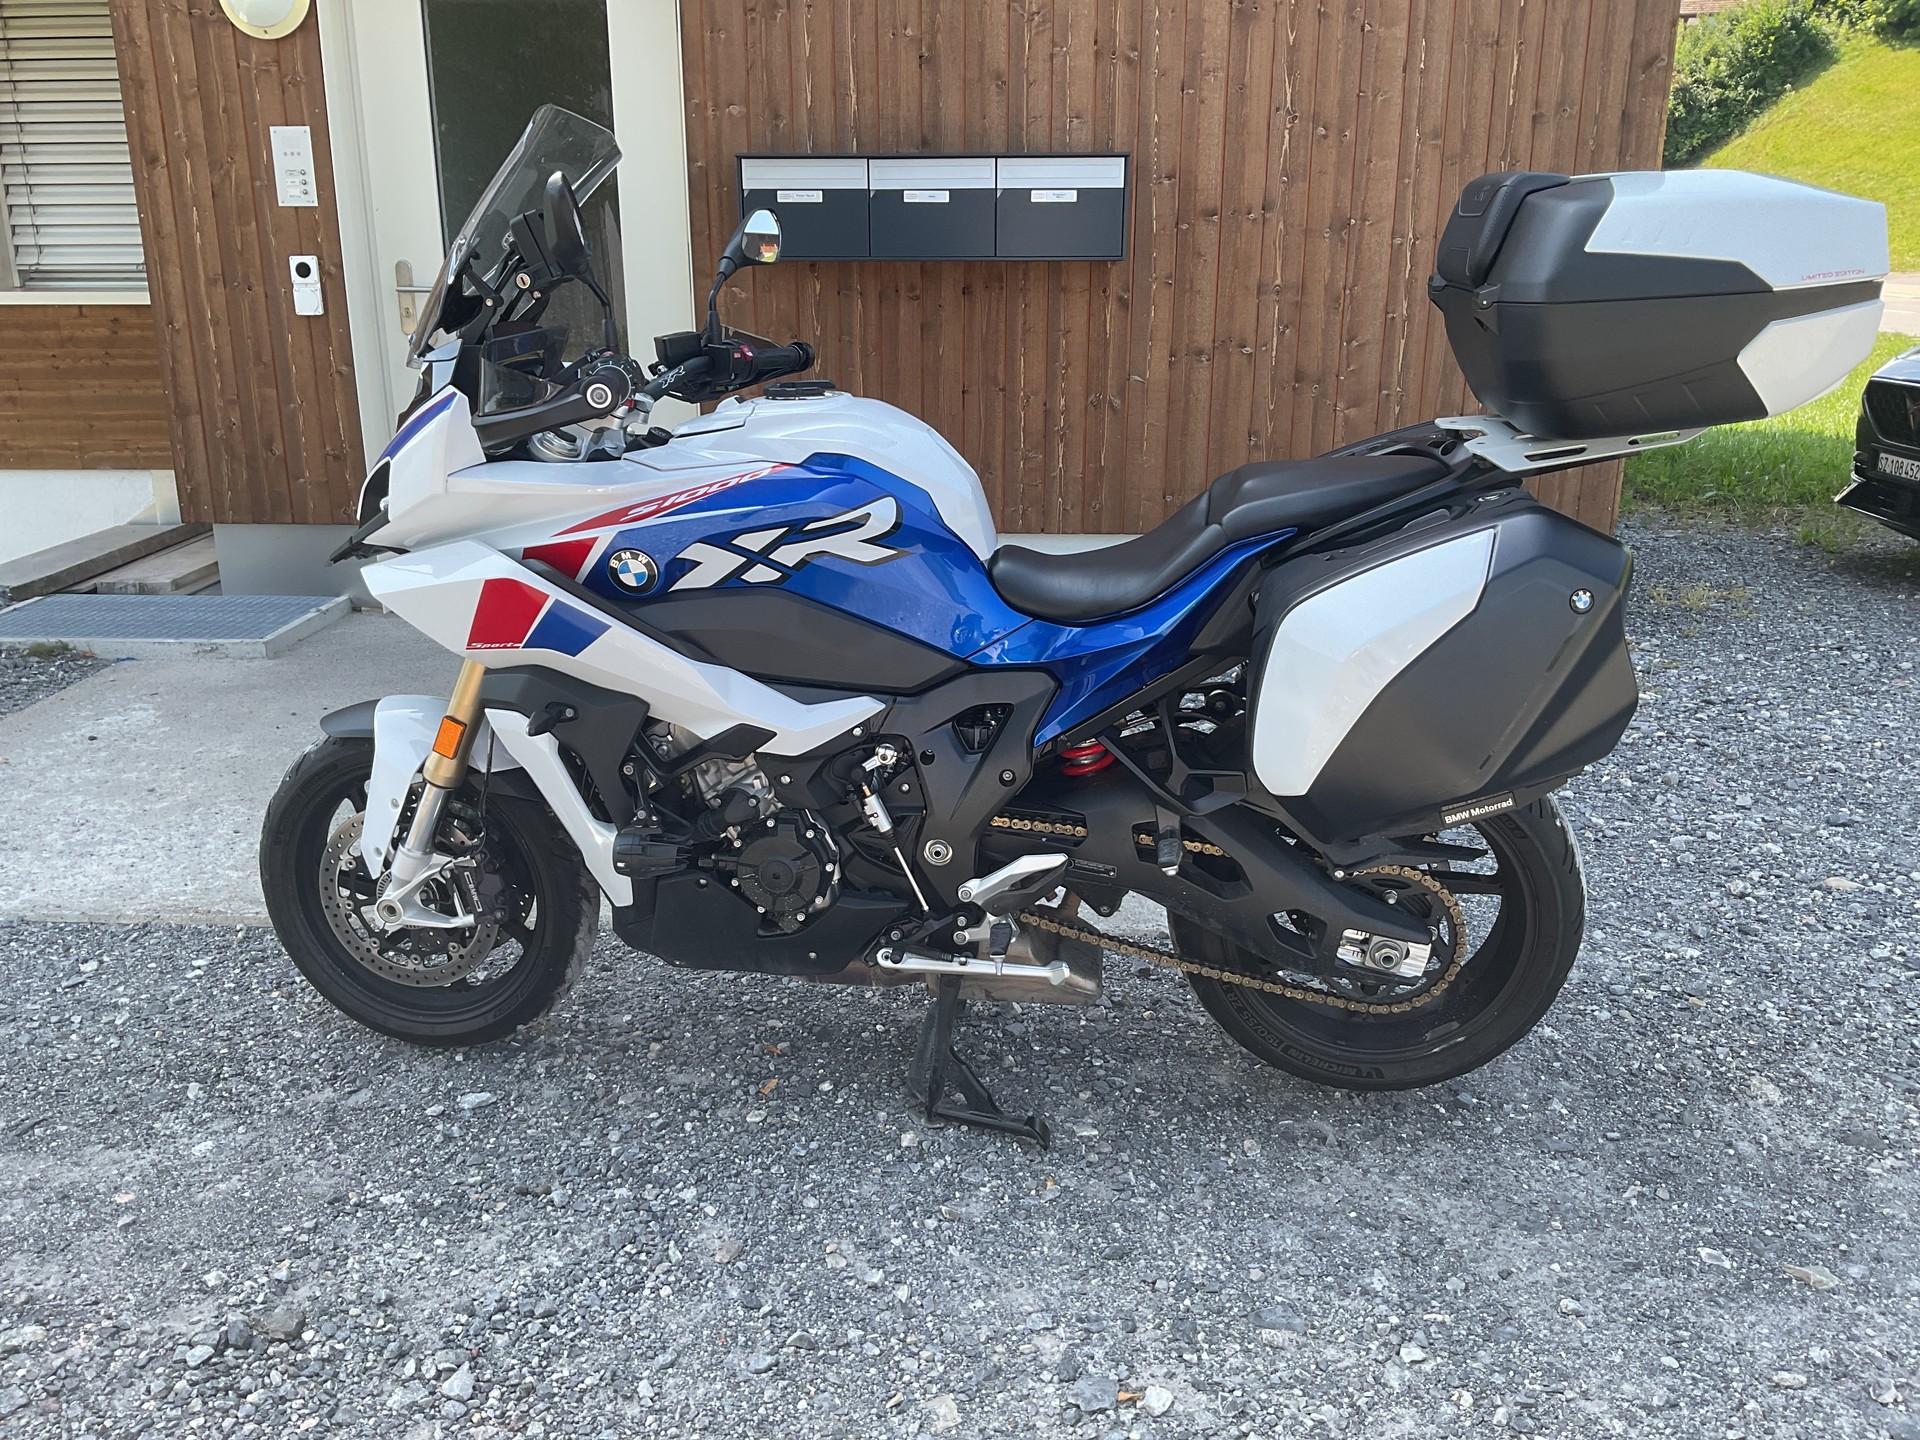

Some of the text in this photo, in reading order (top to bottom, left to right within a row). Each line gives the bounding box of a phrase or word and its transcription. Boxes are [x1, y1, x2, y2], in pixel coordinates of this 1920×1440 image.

[667, 495, 905, 594] XR
[1444, 797, 1514, 824] BMW Motorrad
[1287, 1048, 1362, 1078] MICHELIN
